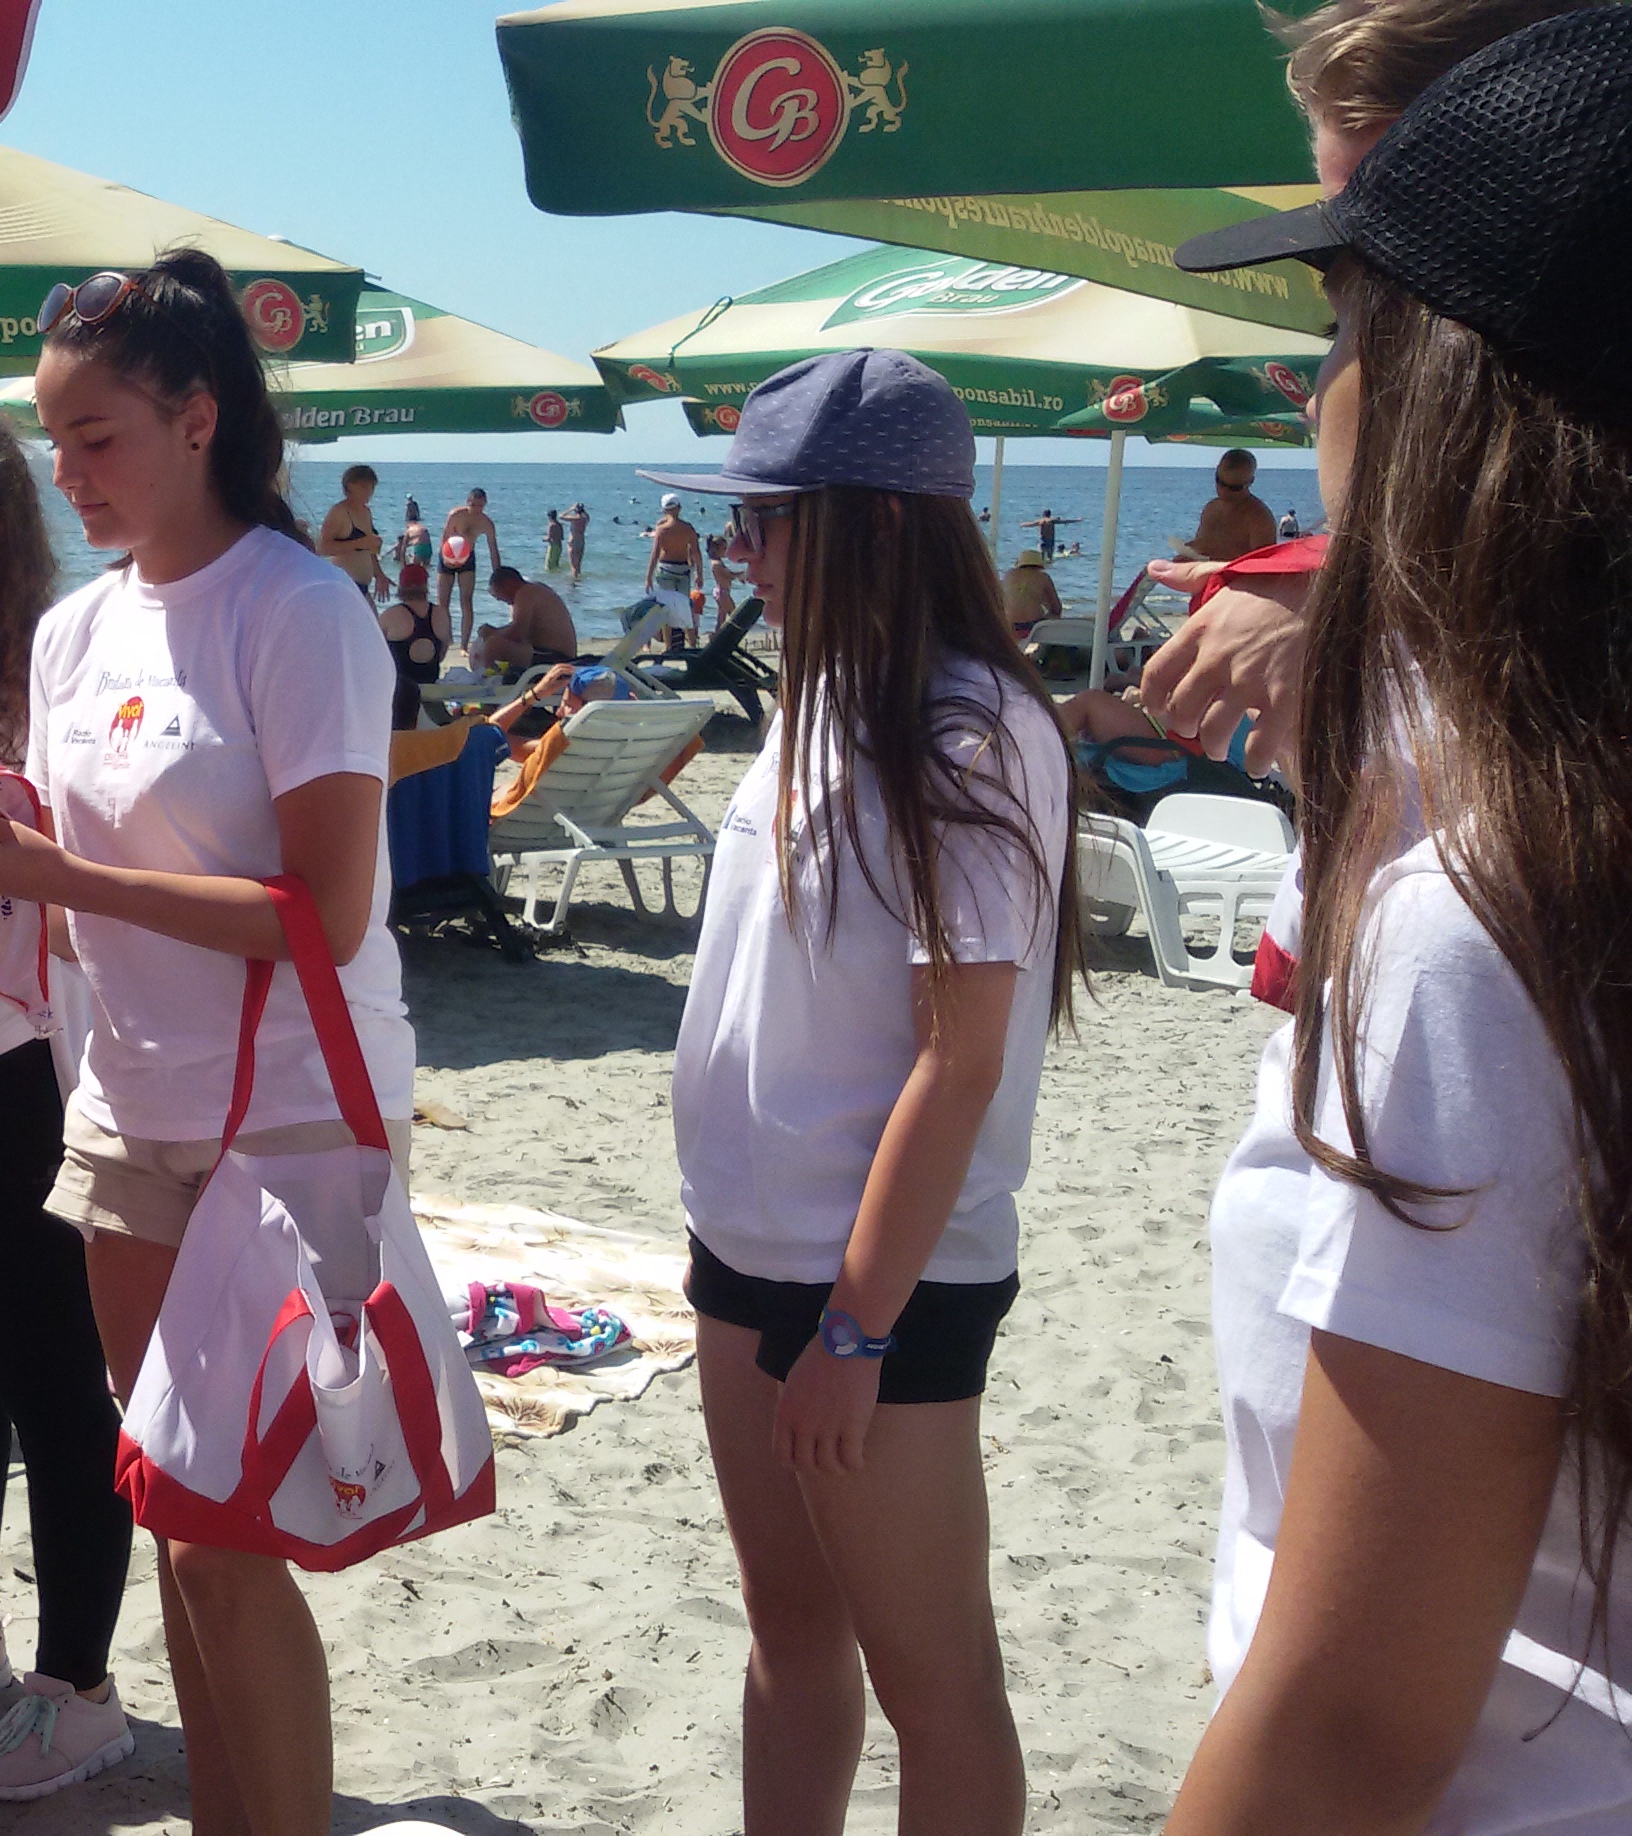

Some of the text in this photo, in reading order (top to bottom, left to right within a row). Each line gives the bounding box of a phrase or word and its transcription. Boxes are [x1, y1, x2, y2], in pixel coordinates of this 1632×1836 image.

[929, 291, 1001, 305] Brau
[349, 405, 416, 426] Brau
[142, 739, 196, 751] ANGELINI
